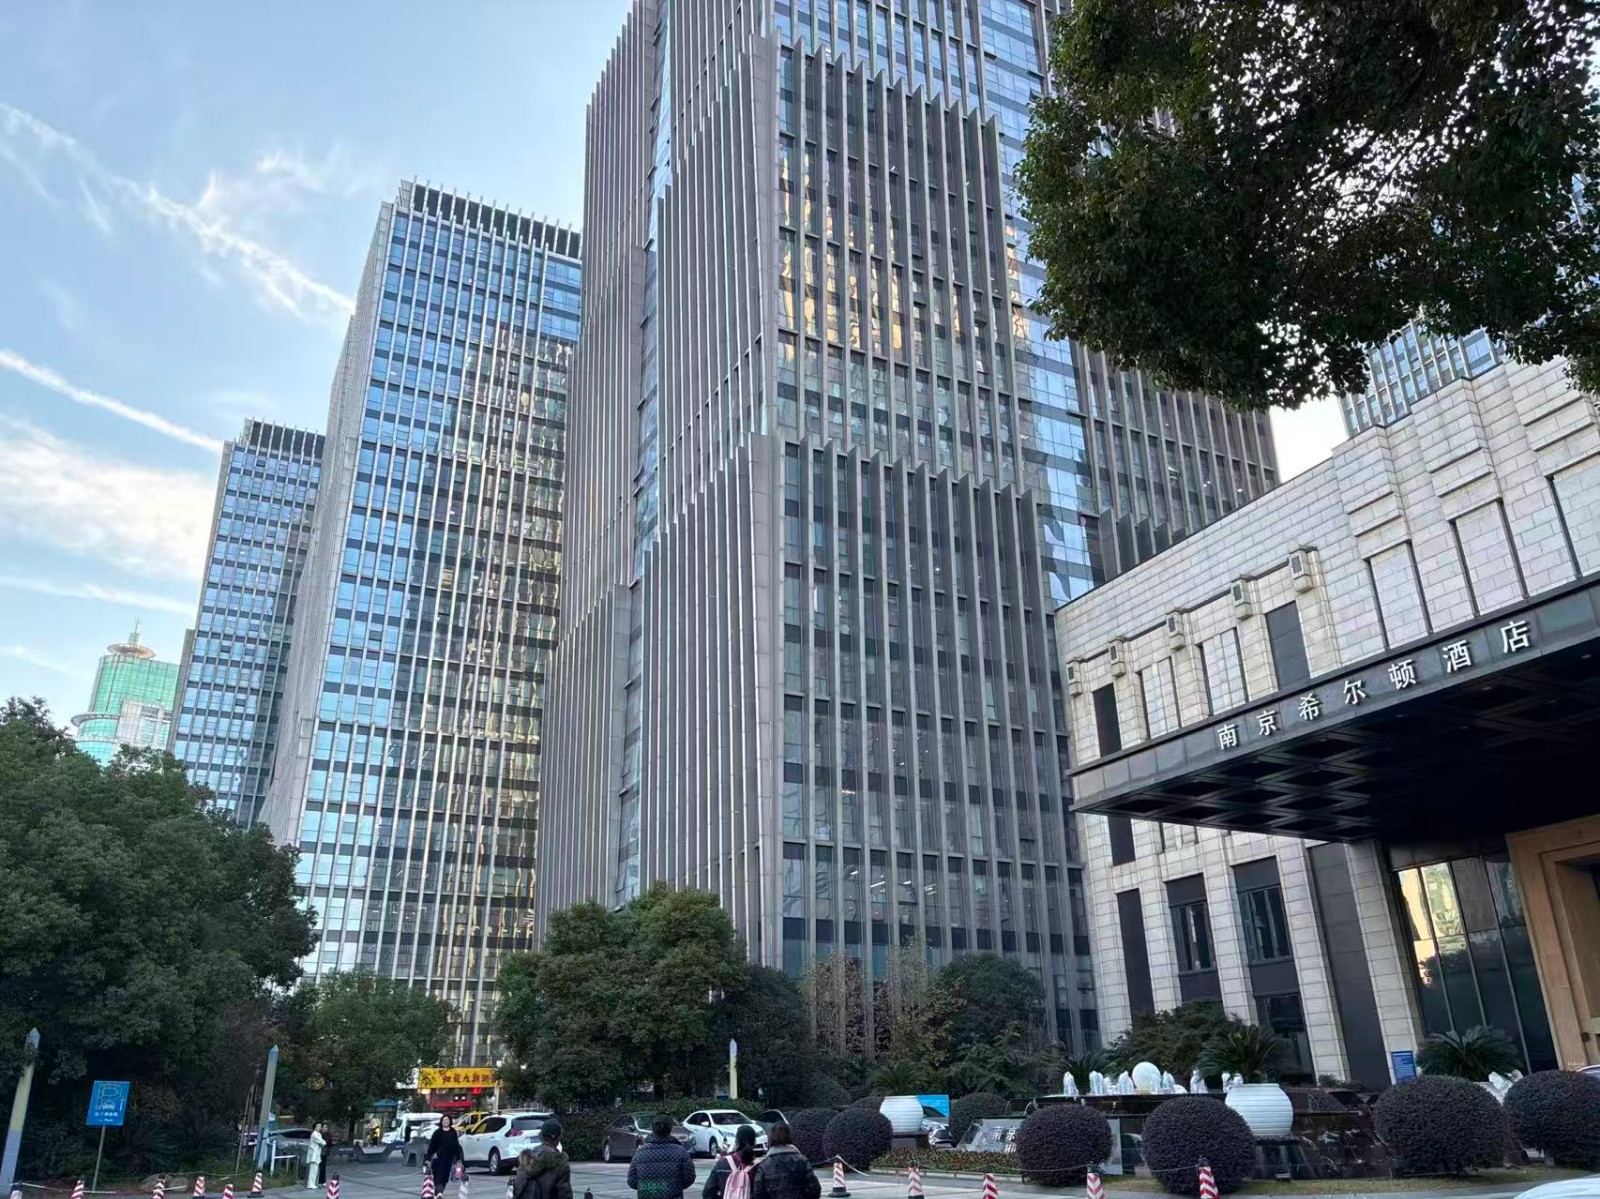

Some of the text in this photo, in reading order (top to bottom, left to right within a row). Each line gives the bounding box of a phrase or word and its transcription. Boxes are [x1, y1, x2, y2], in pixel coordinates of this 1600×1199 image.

[1217, 619, 1531, 750] 南京希尔顿酒店
